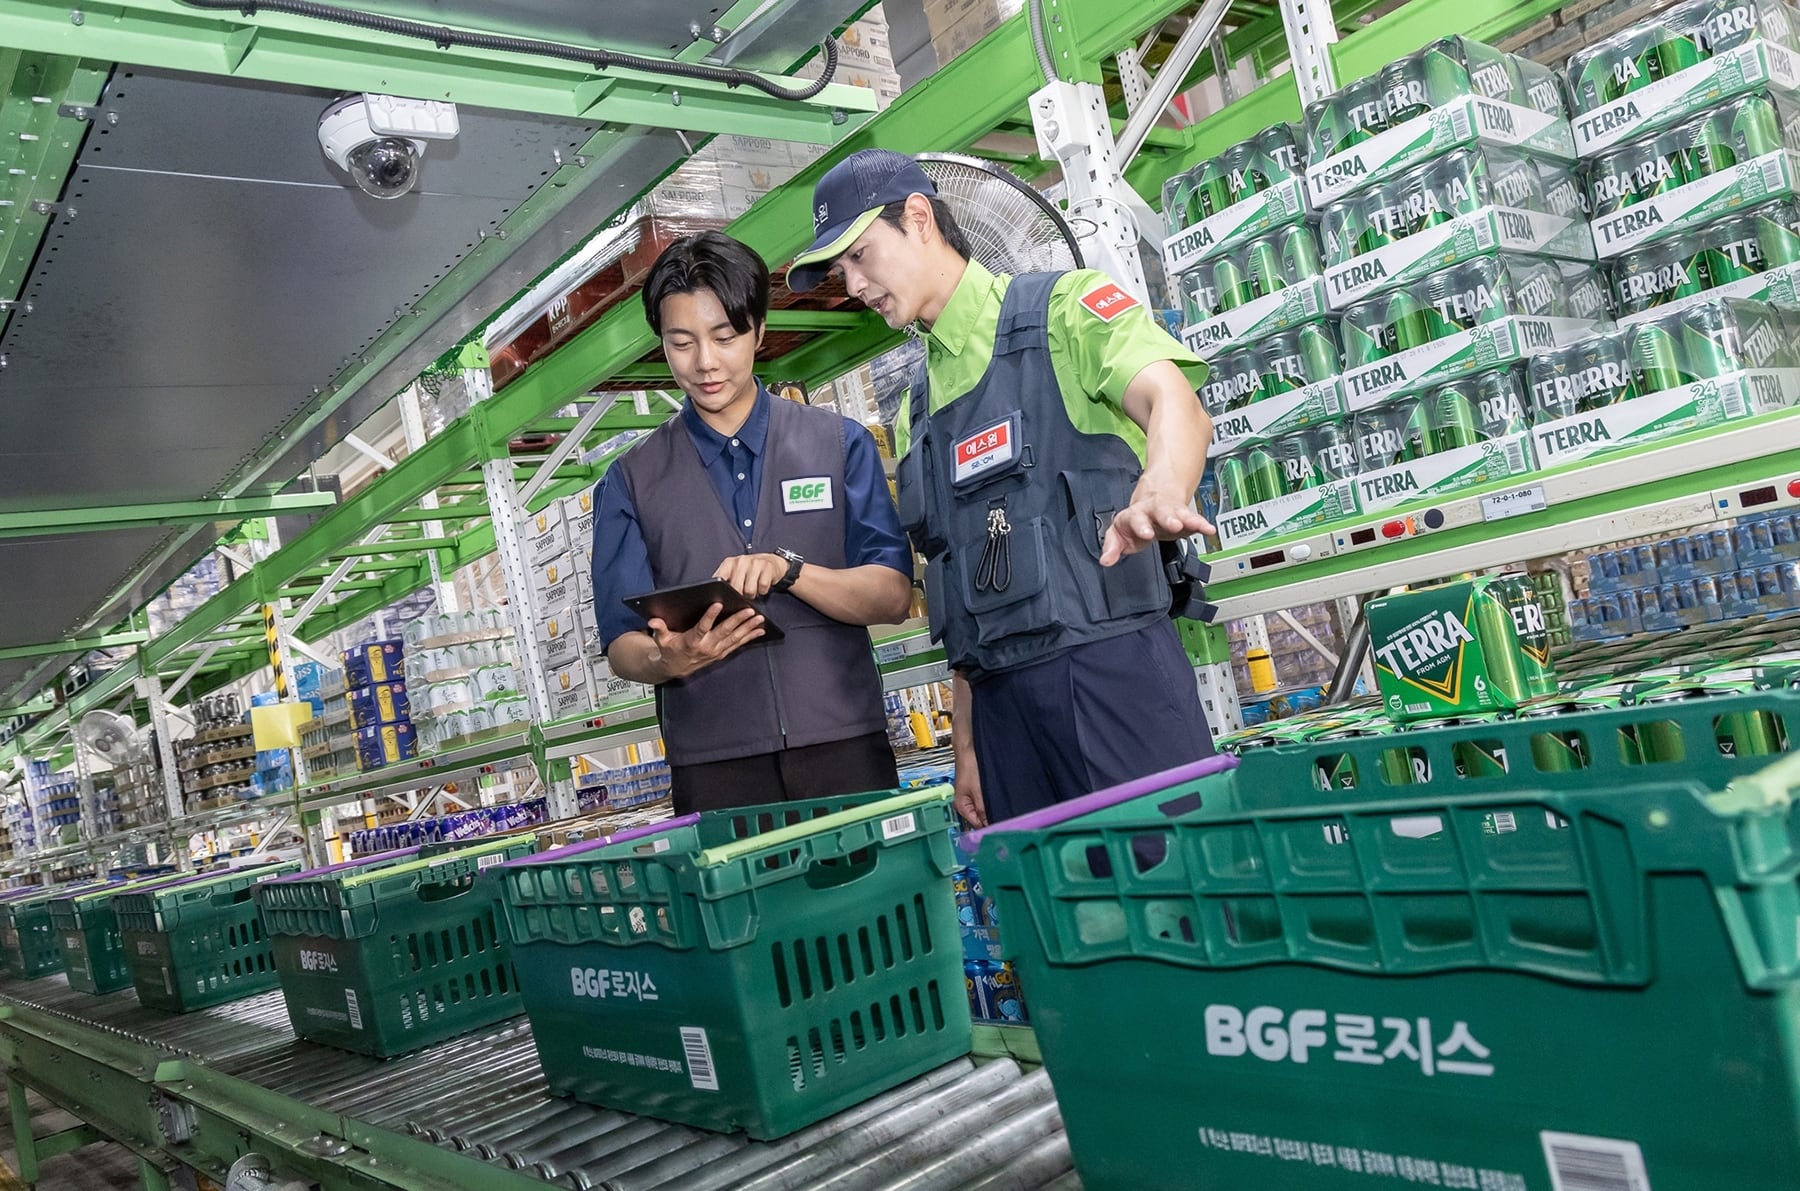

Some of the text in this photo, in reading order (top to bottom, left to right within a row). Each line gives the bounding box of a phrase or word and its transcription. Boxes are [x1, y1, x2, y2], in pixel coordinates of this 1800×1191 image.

[1714, 51, 1738, 71] 24
[1472, 63, 1514, 98] TERRA
[1527, 80, 1562, 113] TERRA
[1429, 108, 1449, 127] 24
[1477, 101, 1517, 137] TERRA
[1577, 101, 1643, 144] TERRA
[1311, 155, 1367, 193] TERRA
[1736, 161, 1759, 179] 24
[1263, 185, 1281, 204] 24
[1494, 169, 1534, 206] TERRA
[1546, 180, 1580, 216] TERRA
[1498, 211, 1536, 243] TERRA
[1598, 205, 1664, 244] TERRA
[1168, 226, 1215, 262] TERRA
[1330, 258, 1387, 295] TERRA
[1764, 268, 1789, 287] 24
[548, 296, 568, 322] KPP
[1282, 286, 1300, 303] 24
[1517, 274, 1556, 315] TERRA
[1569, 279, 1605, 318] TERRA
[1185, 321, 1232, 352] TERRA
[1470, 328, 1491, 342] 24
[1519, 320, 1556, 349] TERRA
[1744, 320, 1781, 367] TERRA
[1348, 361, 1407, 396] TERRA
[1690, 381, 1719, 400] 24
[1751, 374, 1786, 405] TERRA
[965, 432, 998, 455] 에스원
[1539, 418, 1611, 455] TERRA
[789, 483, 825, 500] BGF
[1319, 483, 1337, 499] 24
[1361, 469, 1419, 502] TERRA
[1220, 510, 1269, 539] TERRA
[535, 533, 555, 551] SAPPORO
[546, 585, 566, 602] SAPPORO
[546, 640, 566, 655] SAPPORO
[1376, 611, 1475, 680] TERRA
[1416, 654, 1451, 676] FROM AGM
[606, 679, 631, 692] SAPPORO
[1474, 675, 1486, 692] 6
[558, 692, 578, 707] SAPPORO
[571, 967, 659, 1001] BGF로지스
[1205, 1004, 1495, 1076] BGF로지스
